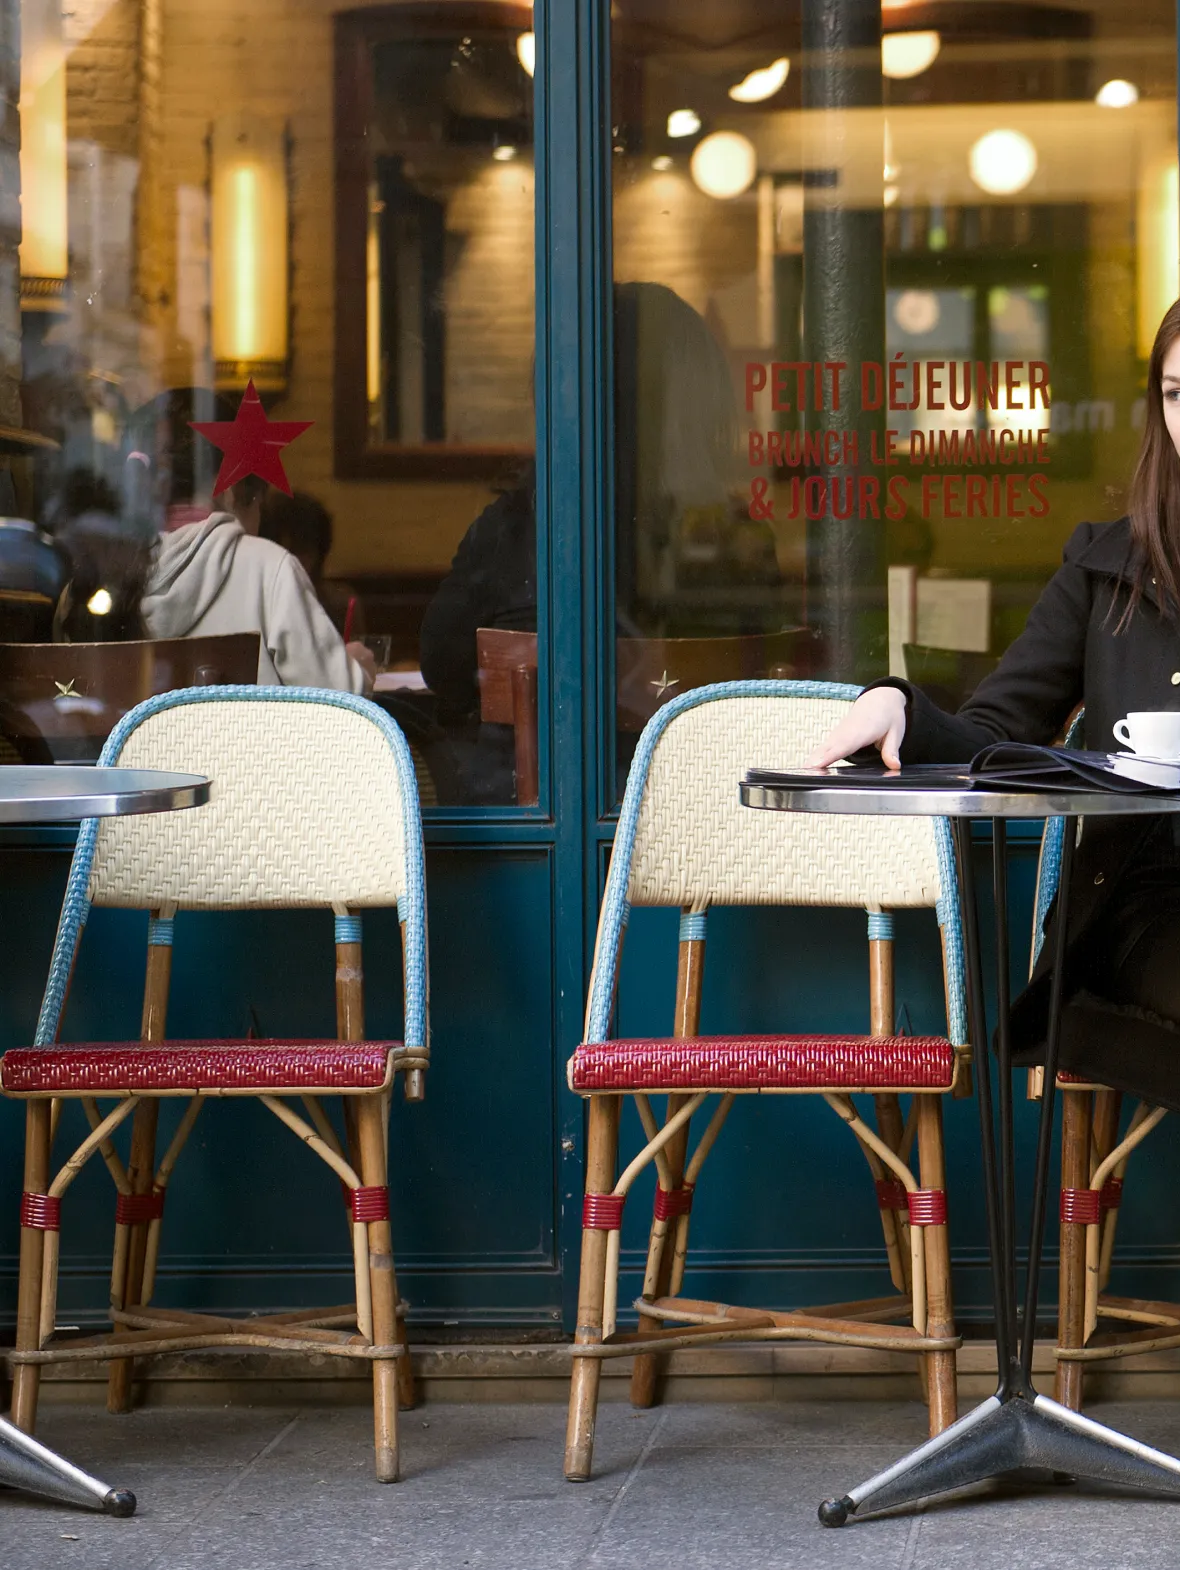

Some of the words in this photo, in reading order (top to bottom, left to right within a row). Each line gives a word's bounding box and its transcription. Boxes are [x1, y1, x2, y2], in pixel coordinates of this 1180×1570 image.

[745, 361, 847, 412] PETIT
[861, 352, 1051, 411] DÉJEUNER
[748, 429, 859, 467] BRUNCH
[871, 430, 899, 466] LE
[910, 428, 1051, 466] DIMANCHE
[748, 476, 775, 521] &
[788, 475, 911, 520] JOURS
[921, 473, 1051, 518] FERIES
